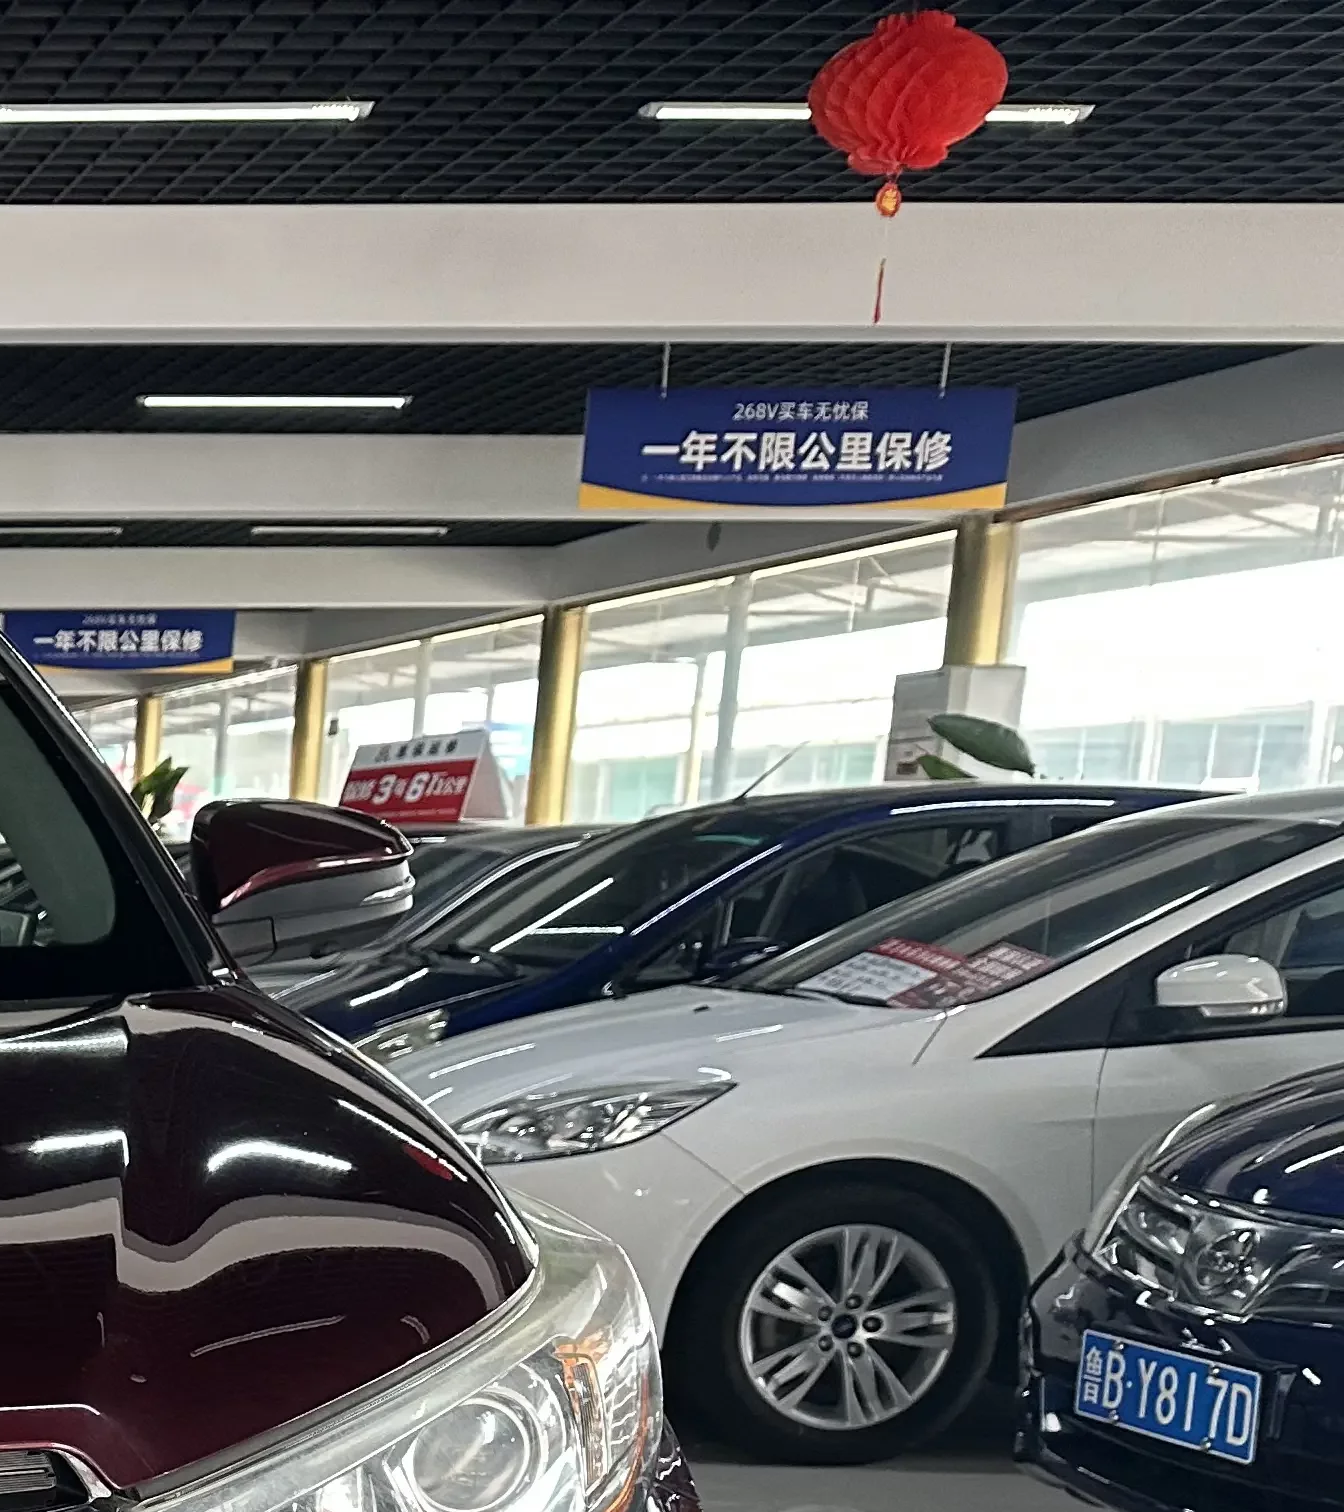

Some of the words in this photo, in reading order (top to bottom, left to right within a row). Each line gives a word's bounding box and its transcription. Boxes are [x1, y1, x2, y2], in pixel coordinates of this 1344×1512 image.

[733, 402, 869, 421] 268V买车无忧保
[642, 430, 952, 472] 一年不限公里保修
